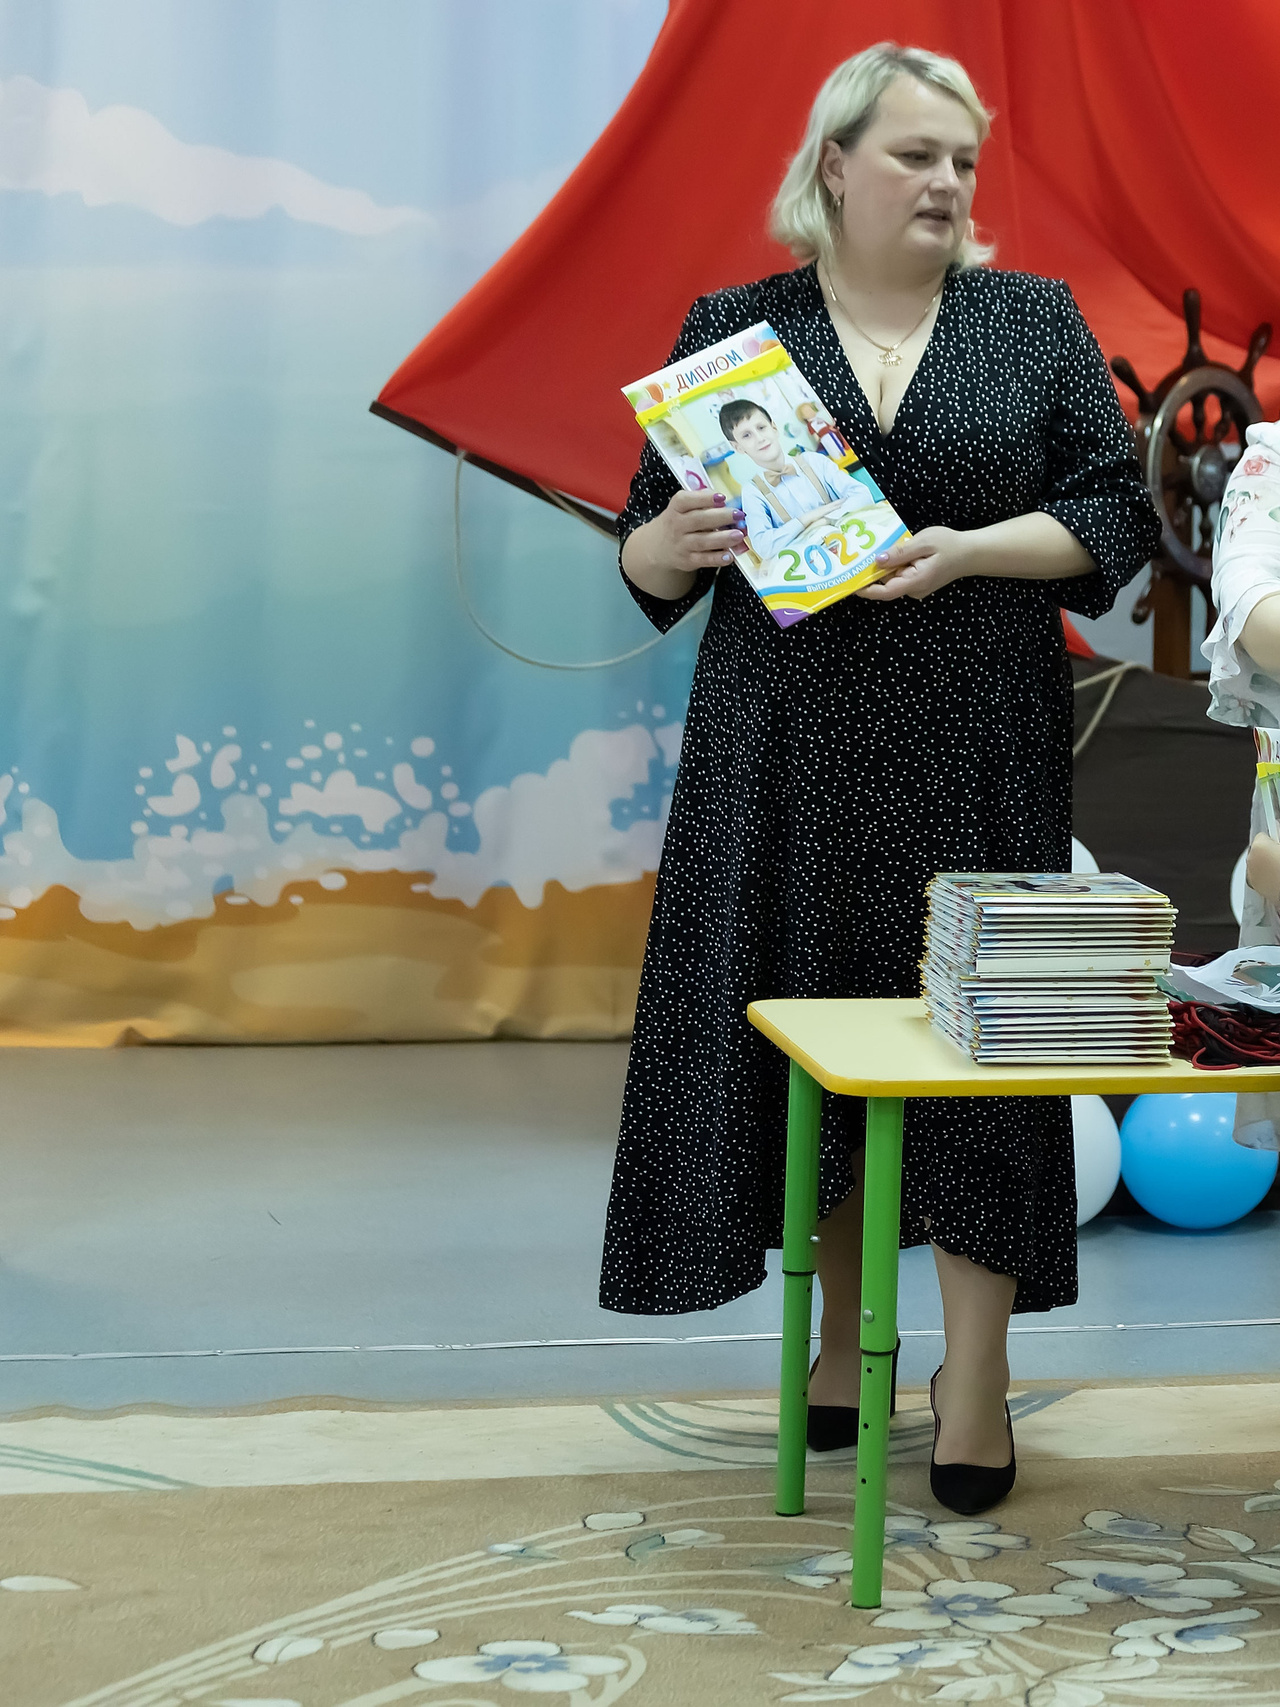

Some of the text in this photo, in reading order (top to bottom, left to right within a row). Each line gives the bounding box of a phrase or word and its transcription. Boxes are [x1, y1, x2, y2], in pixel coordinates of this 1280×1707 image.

[676, 349, 743, 393] ДИПЛОМ
[778, 518, 876, 581] 2023
[805, 572, 853, 593] ВЫПУСКНОЙ
